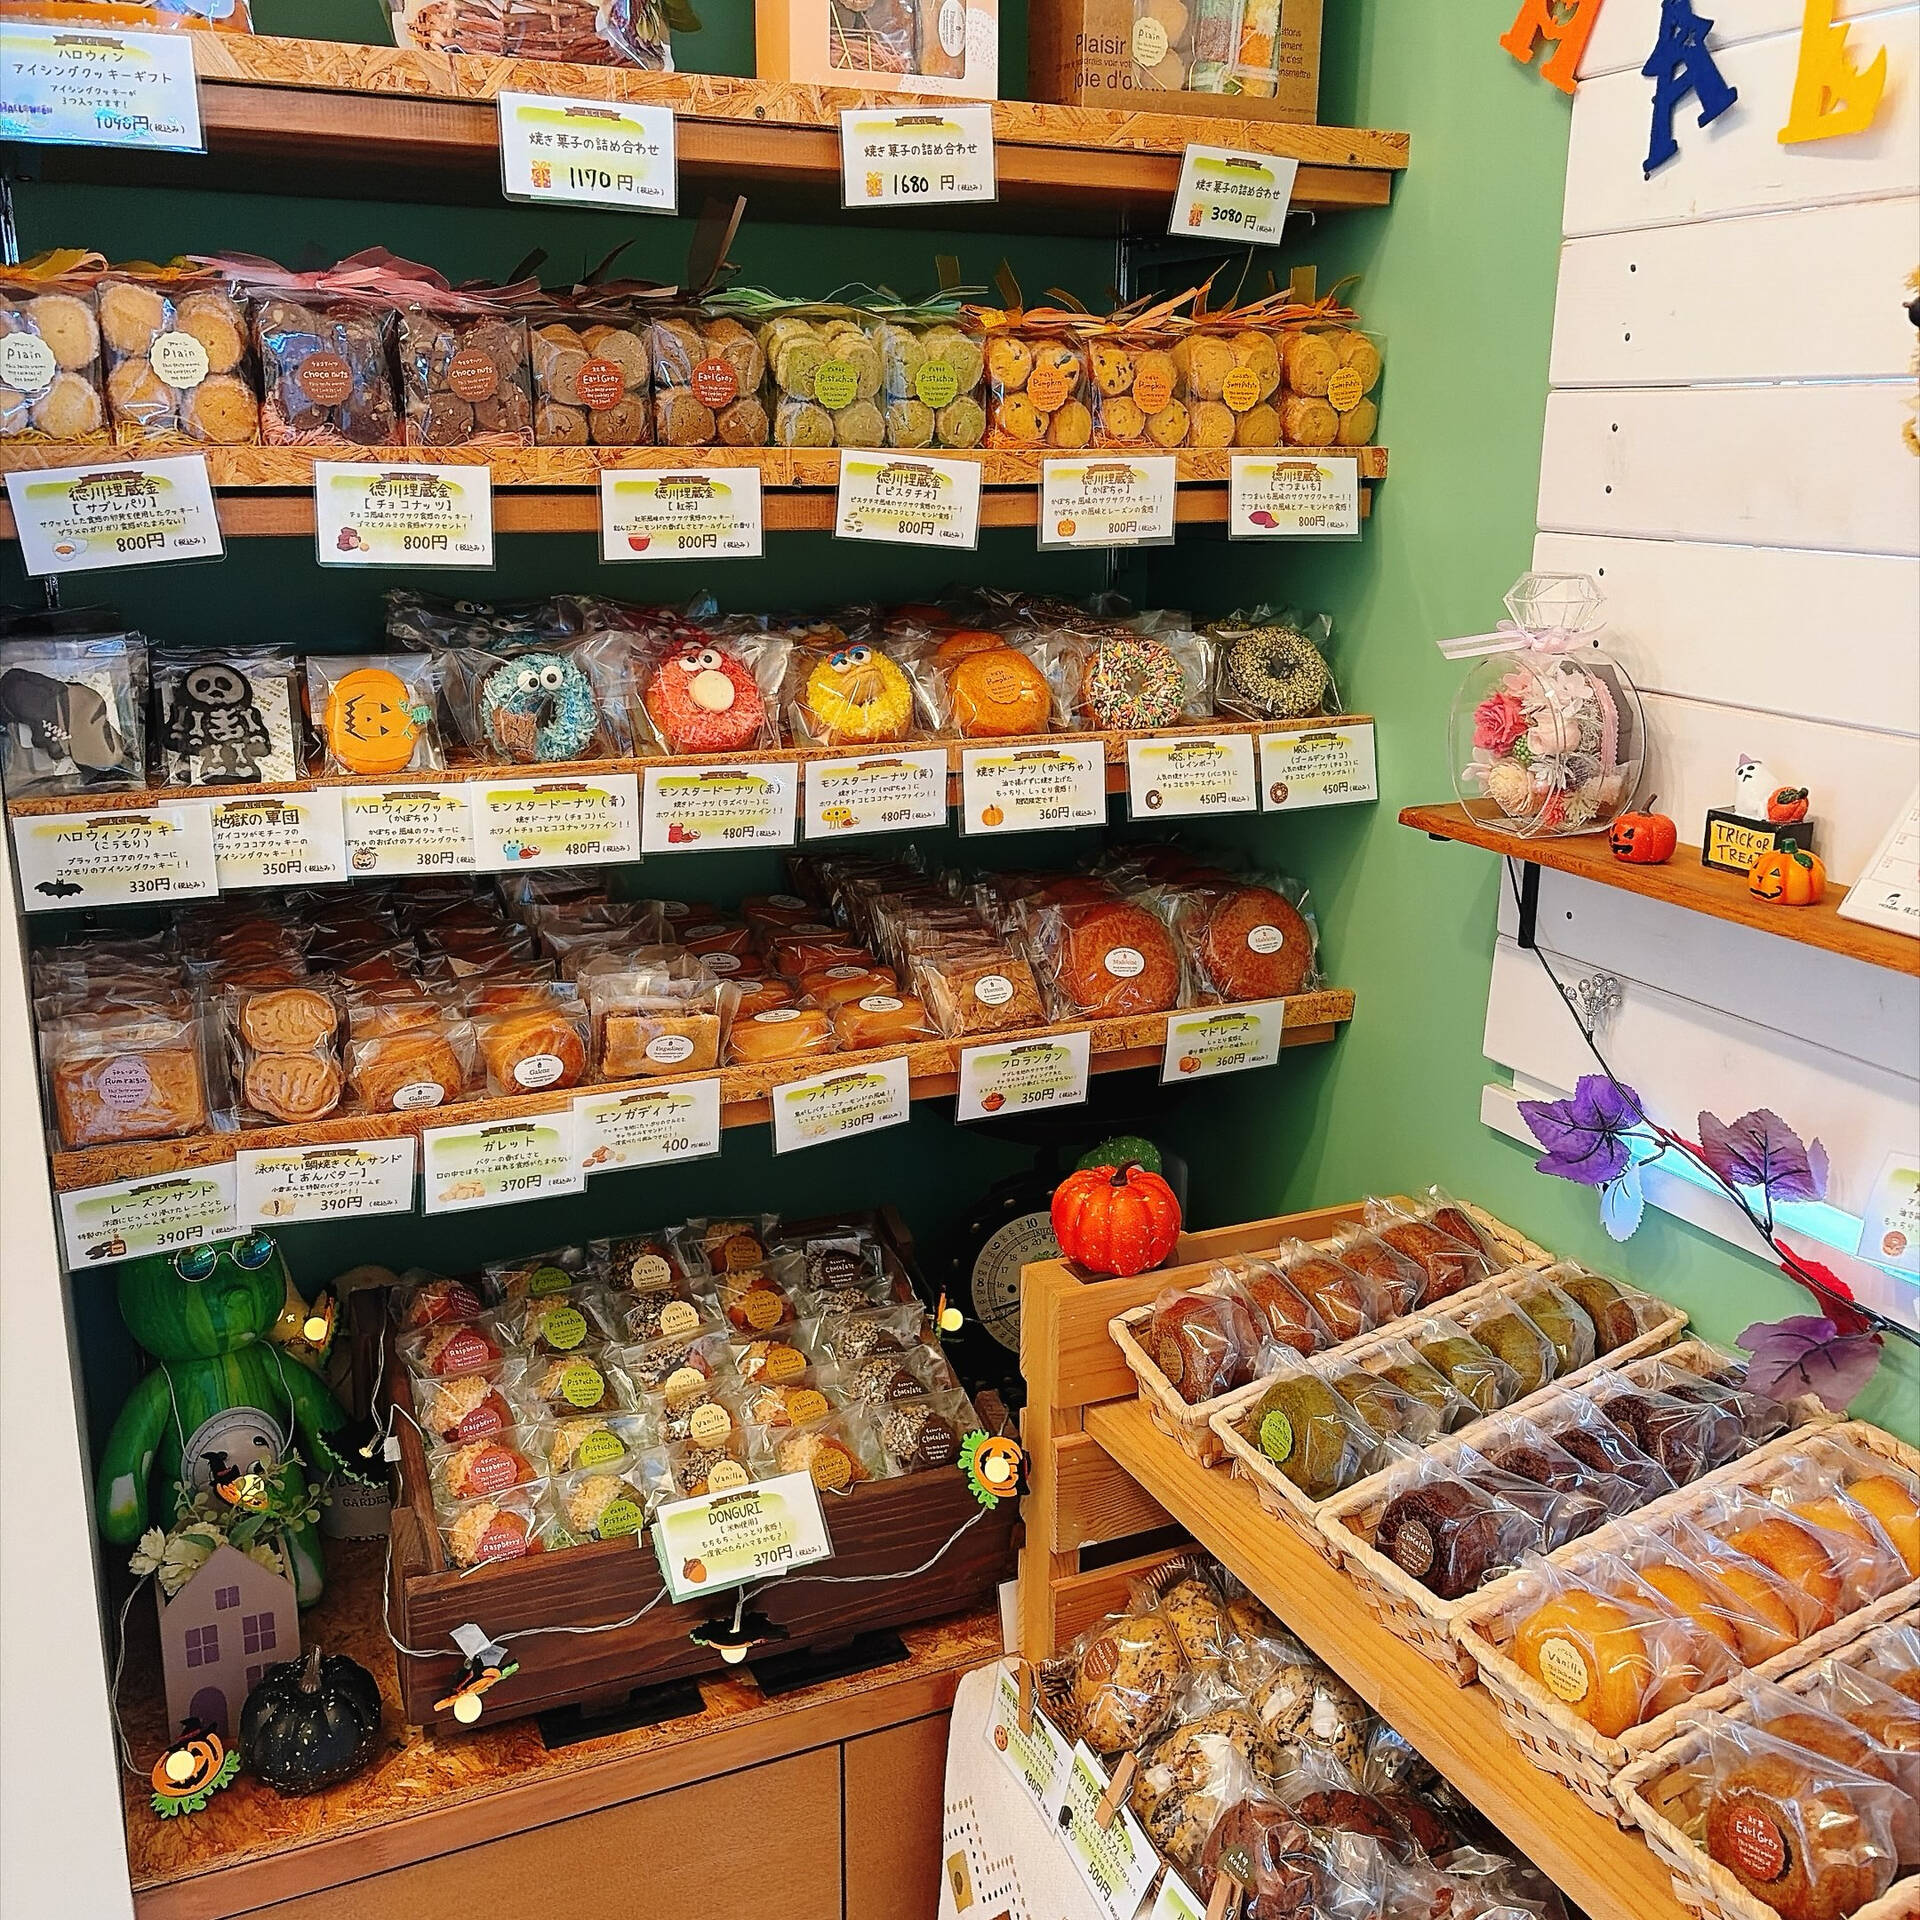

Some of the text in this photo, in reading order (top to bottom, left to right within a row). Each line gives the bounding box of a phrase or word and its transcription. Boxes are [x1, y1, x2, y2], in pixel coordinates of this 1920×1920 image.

[1075, 33, 1126, 54] Plaisir
[58, 48, 124, 62] ハロウィン
[13, 62, 172, 84] アイシングクッキーギフト
[1074, 68, 1100, 93] joie
[528, 131, 660, 156] 焼き菓子の詰め合わせ
[864, 142, 978, 157] 焼き菓子の詰め合わせ
[1196, 179, 1280, 199] 焼き菓子の詰め合わせ
[7, 349, 42, 360] Plain
[163, 348, 196, 359] Plain
[876, 470, 943, 489] 徳川埋蔵金
[68, 479, 160, 501] 徳川埋蔵金
[369, 482, 452, 499] 徳川埋蔵金
[654, 487, 715, 500] 徳川埋蔵金
[899, 520, 934, 535] 800円
[1108, 521, 1136, 533] 800円
[1298, 516, 1325, 527] 800円
[116, 533, 207, 552] 800円 （税込み）
[404, 535, 447, 550] 800円
[678, 534, 717, 549] 800円
[976, 761, 1093, 777] 焼きドーナツ（かぼちゃ）
[821, 768, 934, 788] モンスタードーナツ（黄）
[659, 784, 782, 797] モンスタードーナツ（赤）
[1322, 781, 1348, 794] 450円
[490, 795, 626, 812] モンスタードーナツ（青）
[1200, 792, 1226, 804] 450円
[355, 802, 469, 814] ハロウィンクッキー
[881, 810, 911, 822] 480円
[1039, 806, 1069, 820] 360円
[213, 809, 300, 829] 地獄の軍団
[57, 825, 183, 843] ハロウィンクッキー
[216, 828, 299, 840] ガイコツがモチーフの
[723, 826, 754, 839] 480円
[1716, 823, 1754, 849] TRICK
[94, 840, 150, 851] （こうもり）
[565, 841, 600, 855] 480円
[68, 851, 178, 865] ブラックココアのクッキーに
[417, 852, 454, 865] 380円
[262, 861, 336, 875] 350円 （税込み）
[129, 878, 206, 893] 330円 （税込み）
[1199, 1022, 1250, 1038] マドレーヌ
[1001, 1053, 1062, 1069] フロランタン
[1216, 1053, 1245, 1067] 360円
[808, 1080, 877, 1102] フィナンシェ
[1022, 1088, 1054, 1104] 350円
[596, 1102, 692, 1124] エンガディナー
[840, 1113, 874, 1130] 330円
[483, 1136, 535, 1152] ガレット
[500, 1175, 542, 1192] 370円
[110, 1185, 214, 1214] レーズンサンド
[320, 1196, 362, 1211] 390円
[157, 1225, 203, 1245] 390円
[713, 1472, 742, 1484] Vanilla
[708, 1501, 763, 1525] DONGURI
[754, 1544, 793, 1568] 370円
[1547, 1650, 1583, 1677] Vanilla
[1024, 1769, 1044, 1801] 480円
[1735, 1821, 1779, 1850] Earl Grey
[1087, 1863, 1112, 1901] 500円
